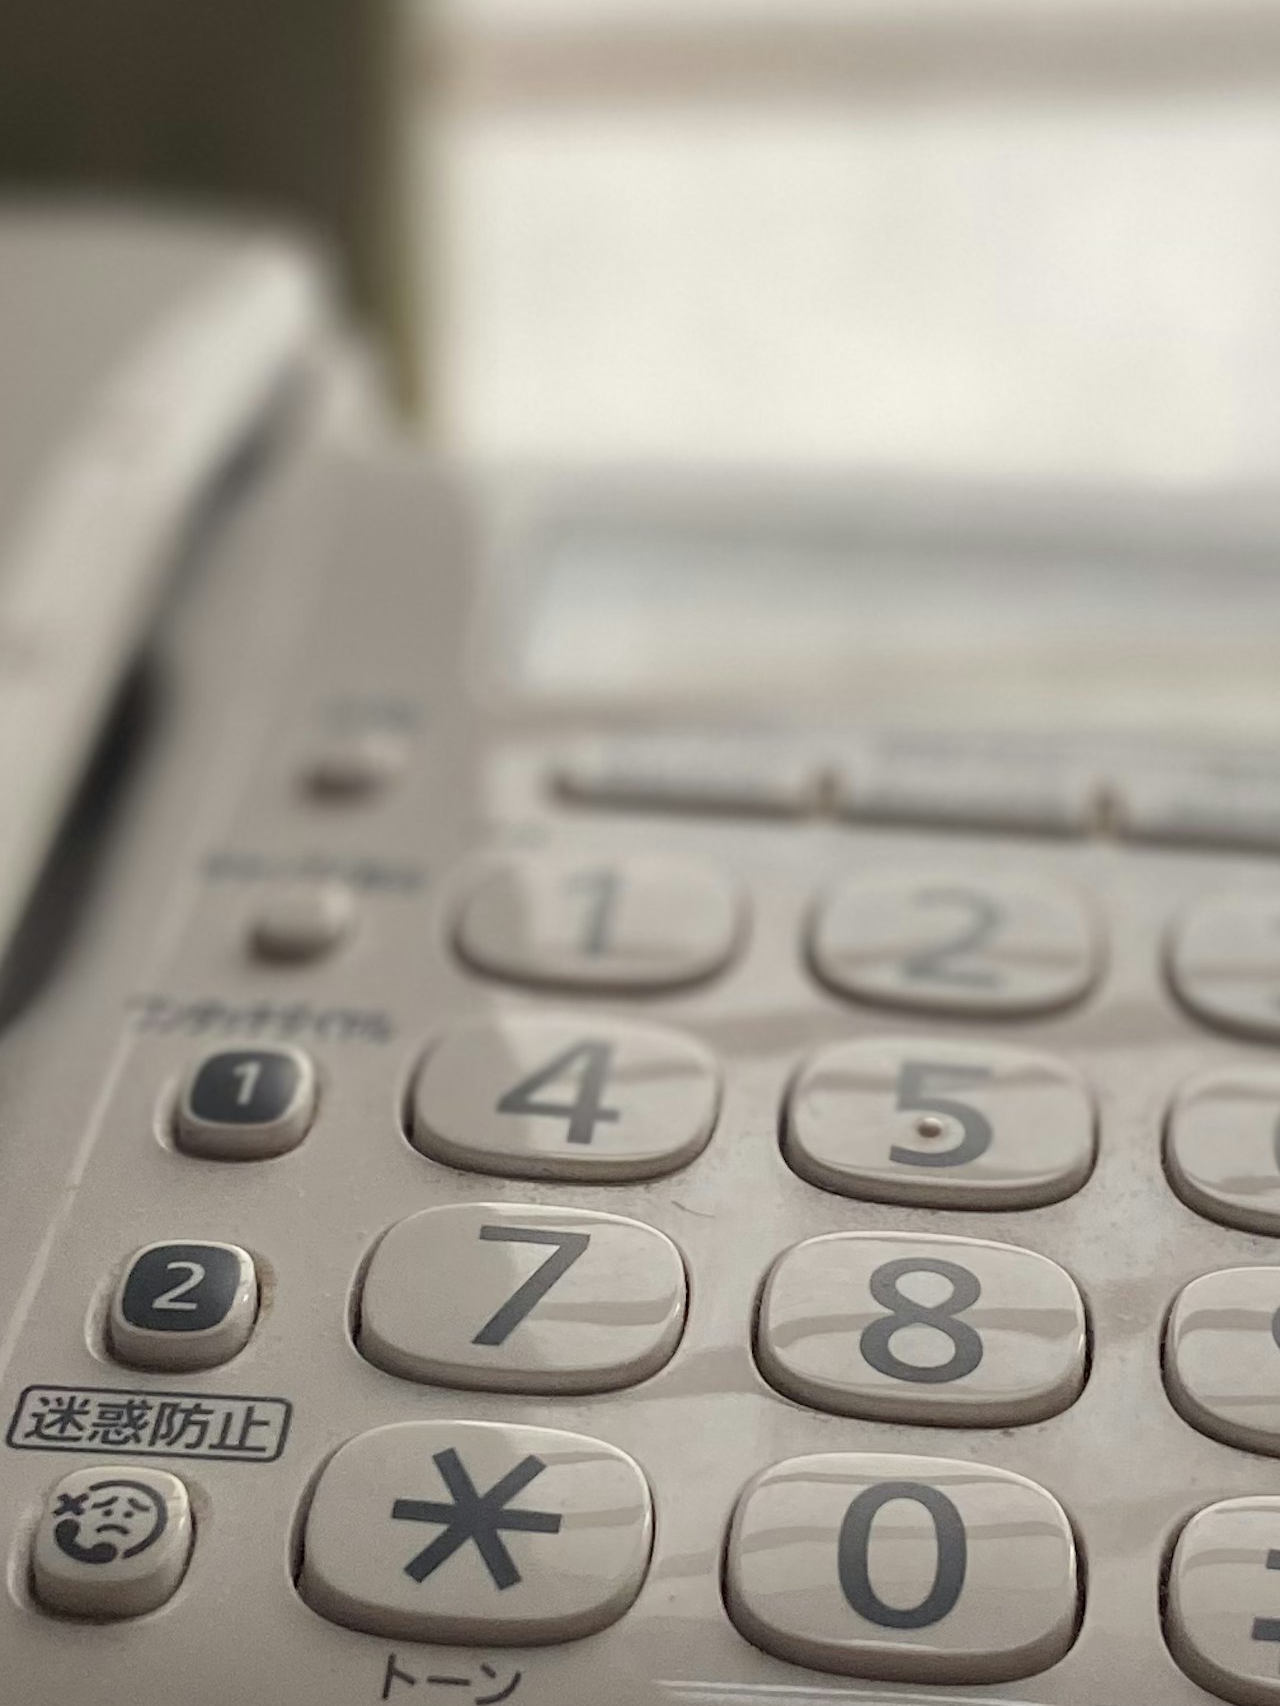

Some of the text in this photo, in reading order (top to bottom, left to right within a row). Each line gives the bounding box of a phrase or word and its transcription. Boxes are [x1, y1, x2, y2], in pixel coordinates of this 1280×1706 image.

[566, 867, 624, 960] 1
[896, 887, 1006, 990] 2
[233, 1062, 261, 1106] 1
[497, 1040, 622, 1145] 4
[889, 1061, 993, 1168] 5
[152, 1261, 205, 1311] 2
[472, 1225, 591, 1346] 7
[859, 1257, 984, 1384] 8
[24, 1395, 270, 1453] 迷惑防止
[837, 1481, 968, 1630] 0
[381, 1654, 523, 1706] トーン
